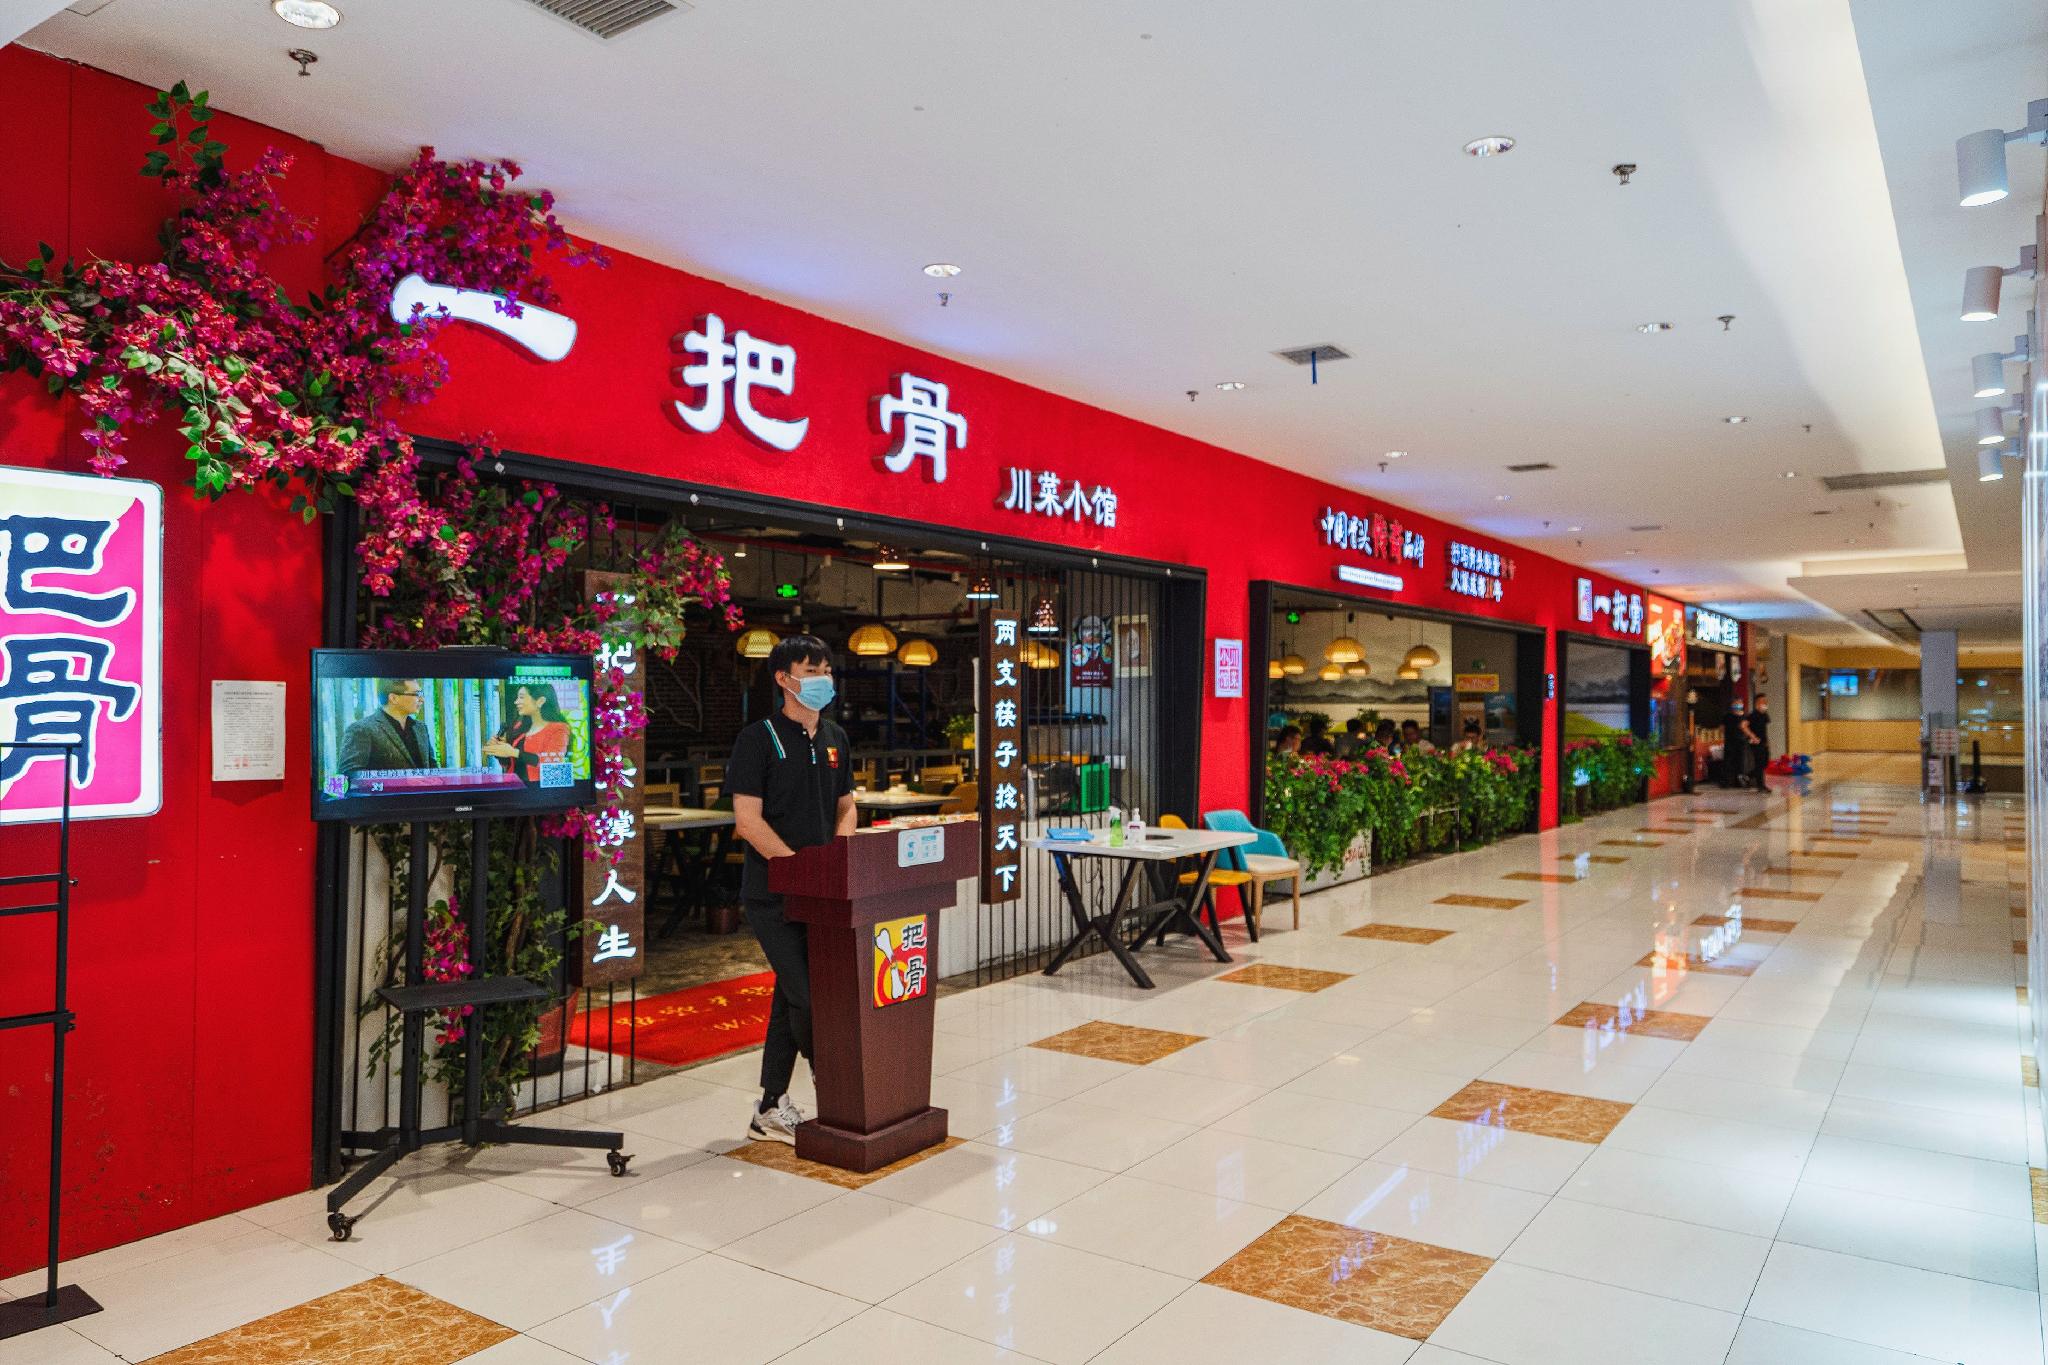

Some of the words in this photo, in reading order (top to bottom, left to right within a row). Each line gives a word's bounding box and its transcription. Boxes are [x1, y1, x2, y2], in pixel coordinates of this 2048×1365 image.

[390, 273, 967, 483] 一把骨
[1004, 466, 1119, 529] 川菜小馆
[902, 921, 927, 995] 把骨
